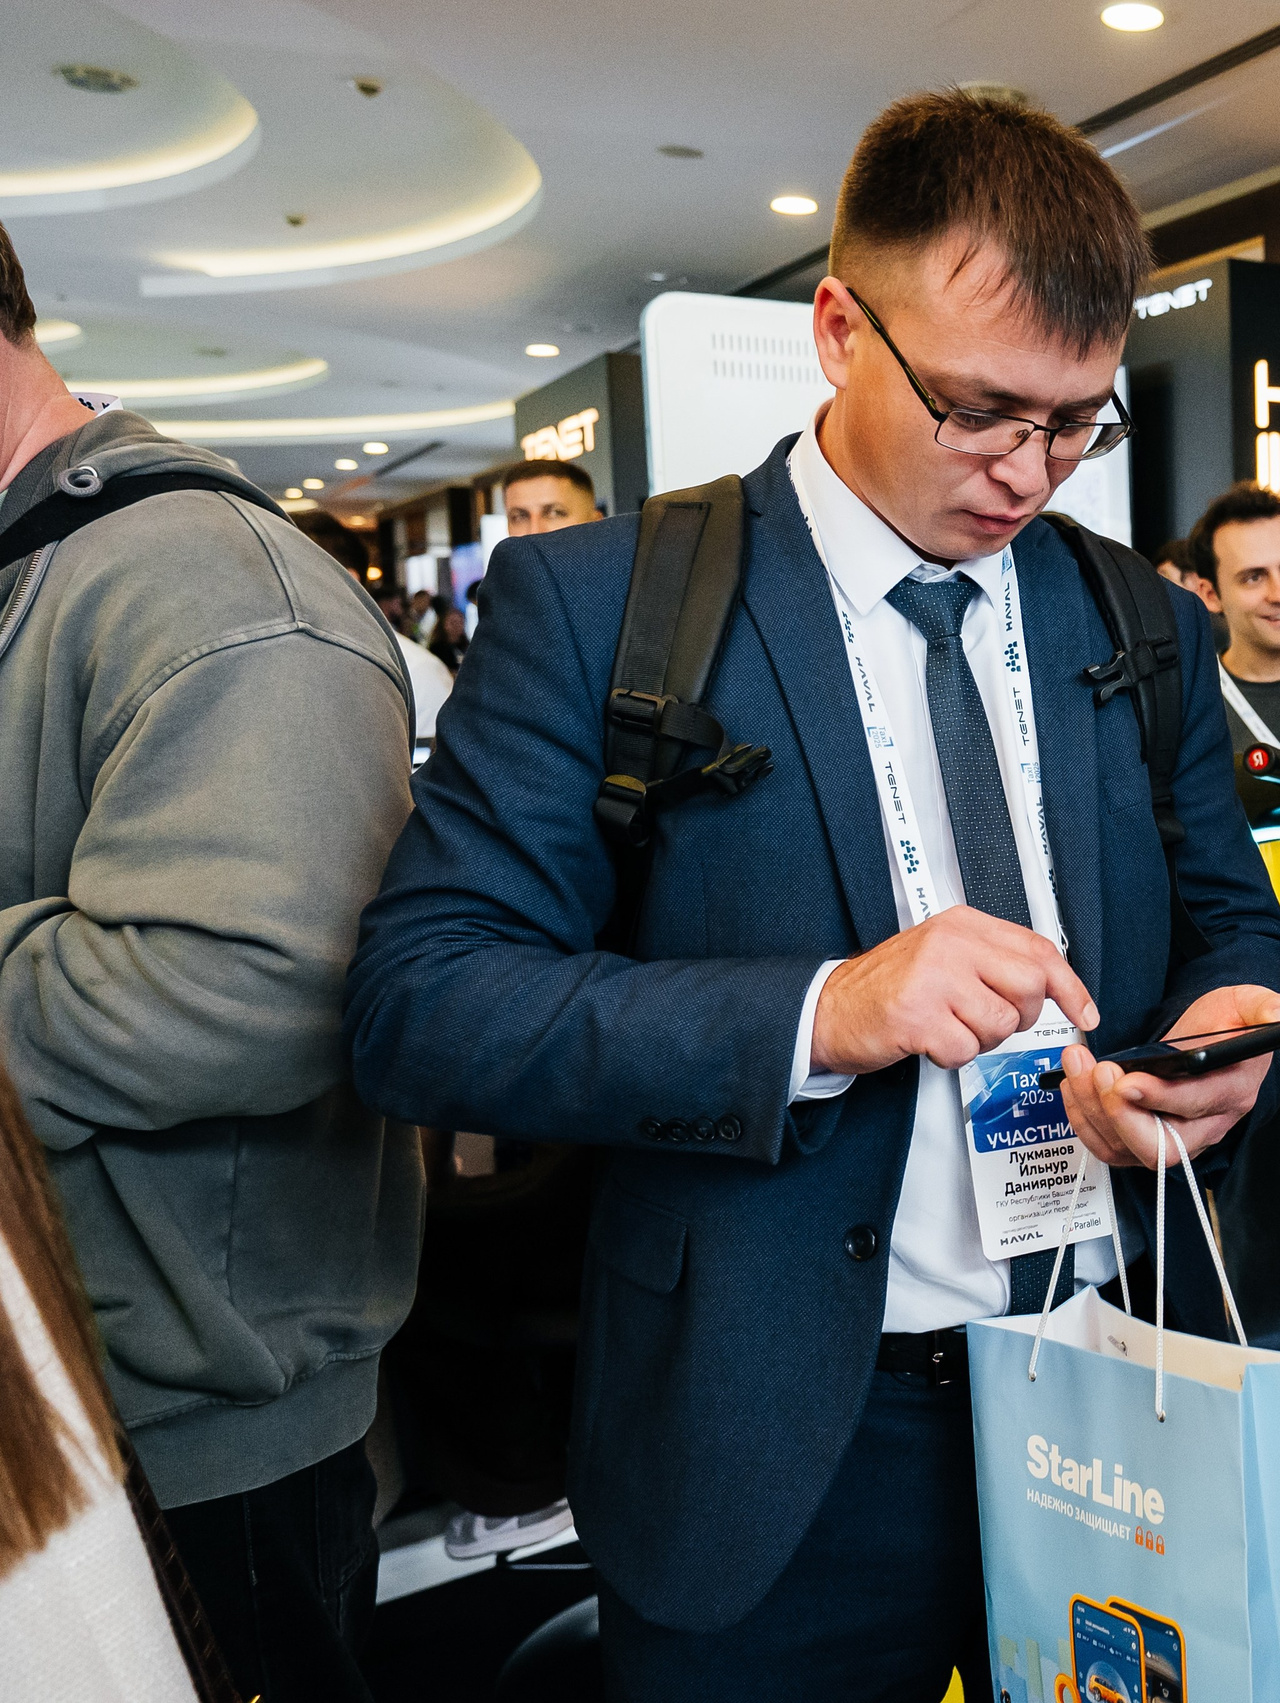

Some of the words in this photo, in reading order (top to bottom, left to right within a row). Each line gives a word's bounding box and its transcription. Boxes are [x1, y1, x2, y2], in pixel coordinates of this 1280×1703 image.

[1133, 278, 1213, 319] TENET
[1004, 582, 1013, 632] HAVAL
[855, 656, 875, 712] HAVAL
[1013, 687, 1030, 746] TENET
[872, 731, 882, 748] 2025
[879, 726, 889, 744] Taxi
[1027, 767, 1035, 784] Taxi
[885, 761, 906, 824] TENET
[1034, 1026, 1077, 1037] TENET
[1009, 1067, 1042, 1089] Tax
[1020, 1089, 1054, 1106] 2025
[986, 1122, 1078, 1149] УЧАСТНИ
[1009, 1145, 1075, 1164] Лукманов
[1019, 1160, 1068, 1177] Ильнур
[1051, 1185, 1097, 1199] Башкоостан
[1053, 1201, 1089, 1213] перезок"
[1073, 1217, 1102, 1230] Parallel
[1000, 1231, 1044, 1246] HAVAL
[1027, 1434, 1165, 1525] StarLine
[1026, 1488, 1074, 1518] НАДЕЖНО
[1075, 1507, 1131, 1541] ЗАЩИЩАЕТ
